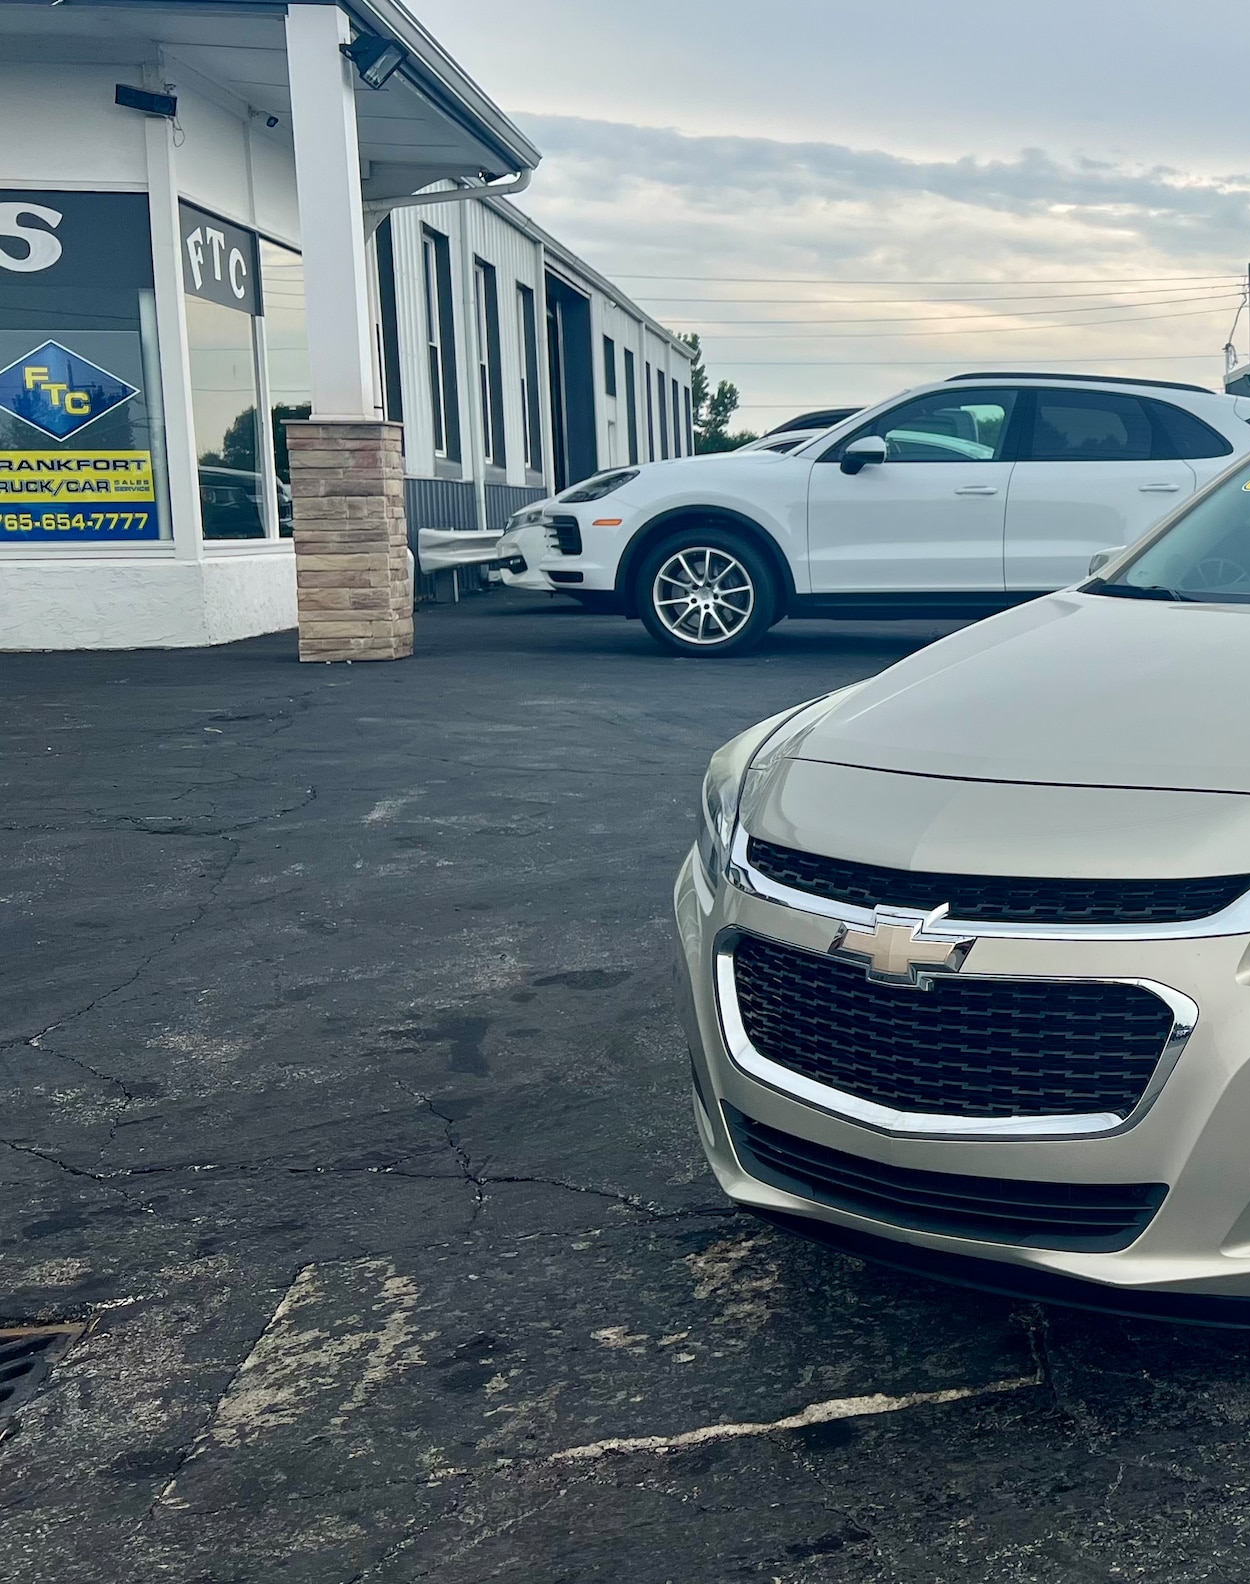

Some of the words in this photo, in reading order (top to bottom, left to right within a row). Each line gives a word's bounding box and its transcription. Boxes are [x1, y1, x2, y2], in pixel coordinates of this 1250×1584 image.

[0, 202, 63, 273] S
[186, 226, 247, 300] FTC
[24, 367, 90, 415] FTC
[0, 512, 149, 531] 65-654-7777
